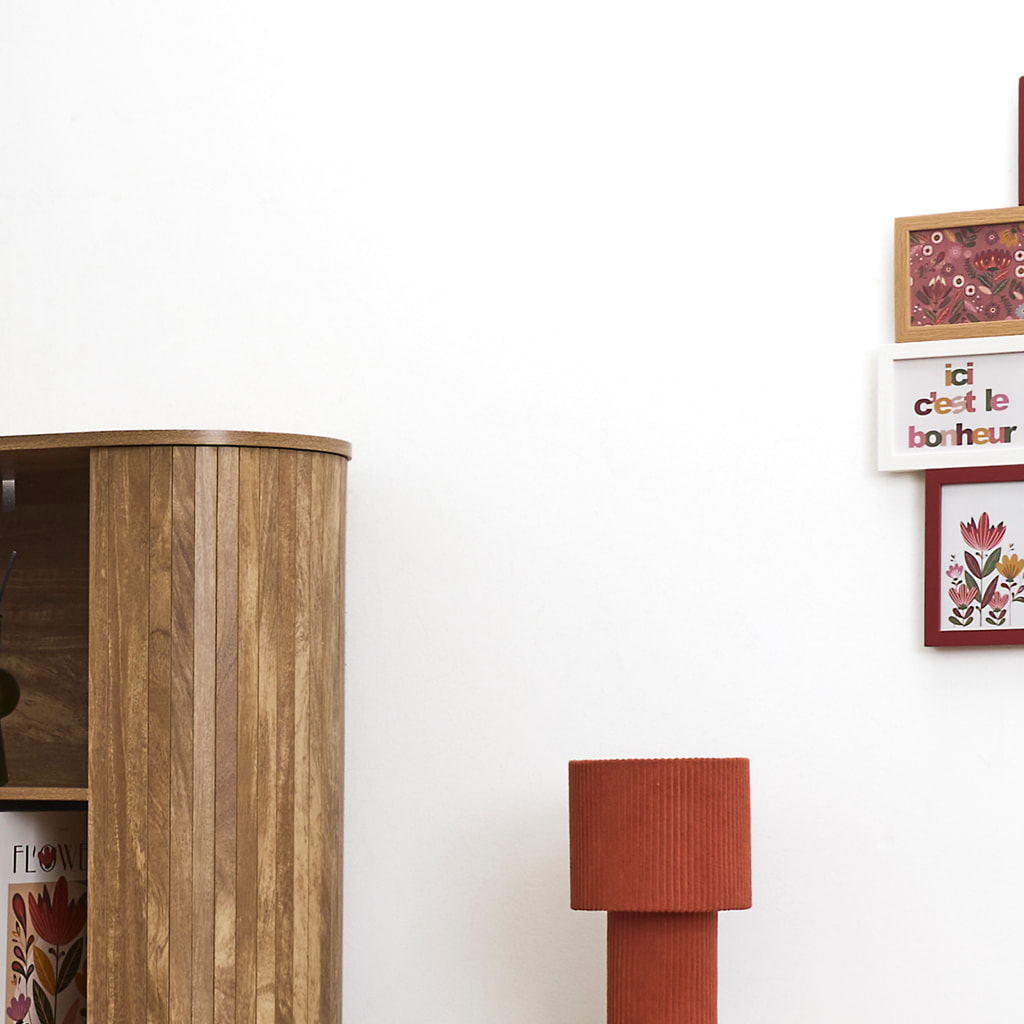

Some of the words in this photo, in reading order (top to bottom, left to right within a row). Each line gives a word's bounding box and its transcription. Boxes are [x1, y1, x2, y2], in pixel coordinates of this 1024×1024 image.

[945, 362, 973, 386] ici
[914, 391, 976, 415] c'est
[985, 388, 1009, 411] le
[908, 423, 1017, 448] bonheur
